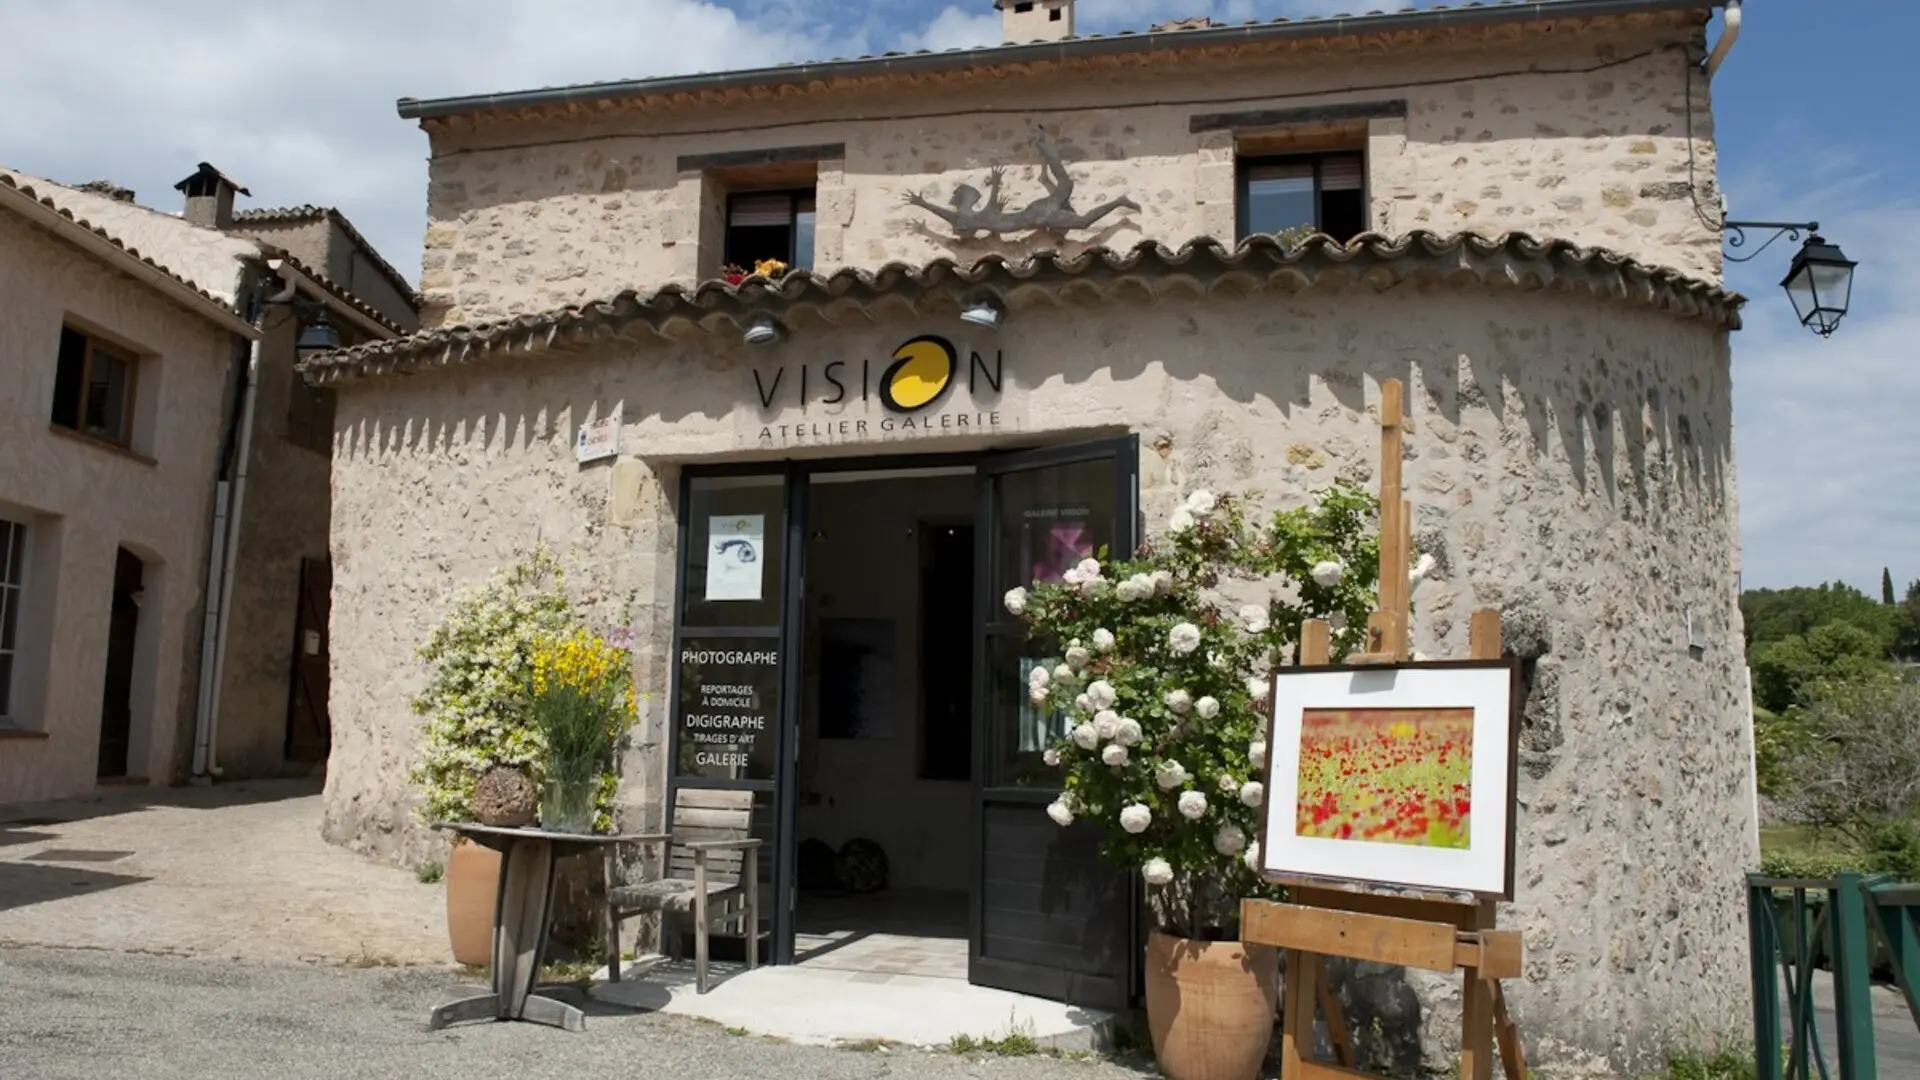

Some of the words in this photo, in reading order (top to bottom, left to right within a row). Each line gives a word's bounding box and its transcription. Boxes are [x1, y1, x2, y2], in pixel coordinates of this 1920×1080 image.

[753, 334, 1002, 413] VISION
[759, 420, 867, 439] ATELIER
[880, 411, 1000, 431] GALERIE
[682, 651, 777, 664] PHOTOGRAPHE
[701, 684, 753, 695] REPORTAGES
[711, 697, 751, 707] DOMICILE
[686, 714, 765, 729] DIGIGRAPHE
[694, 733, 727, 743] TIRAGES
[696, 752, 748, 766] GALERIE
